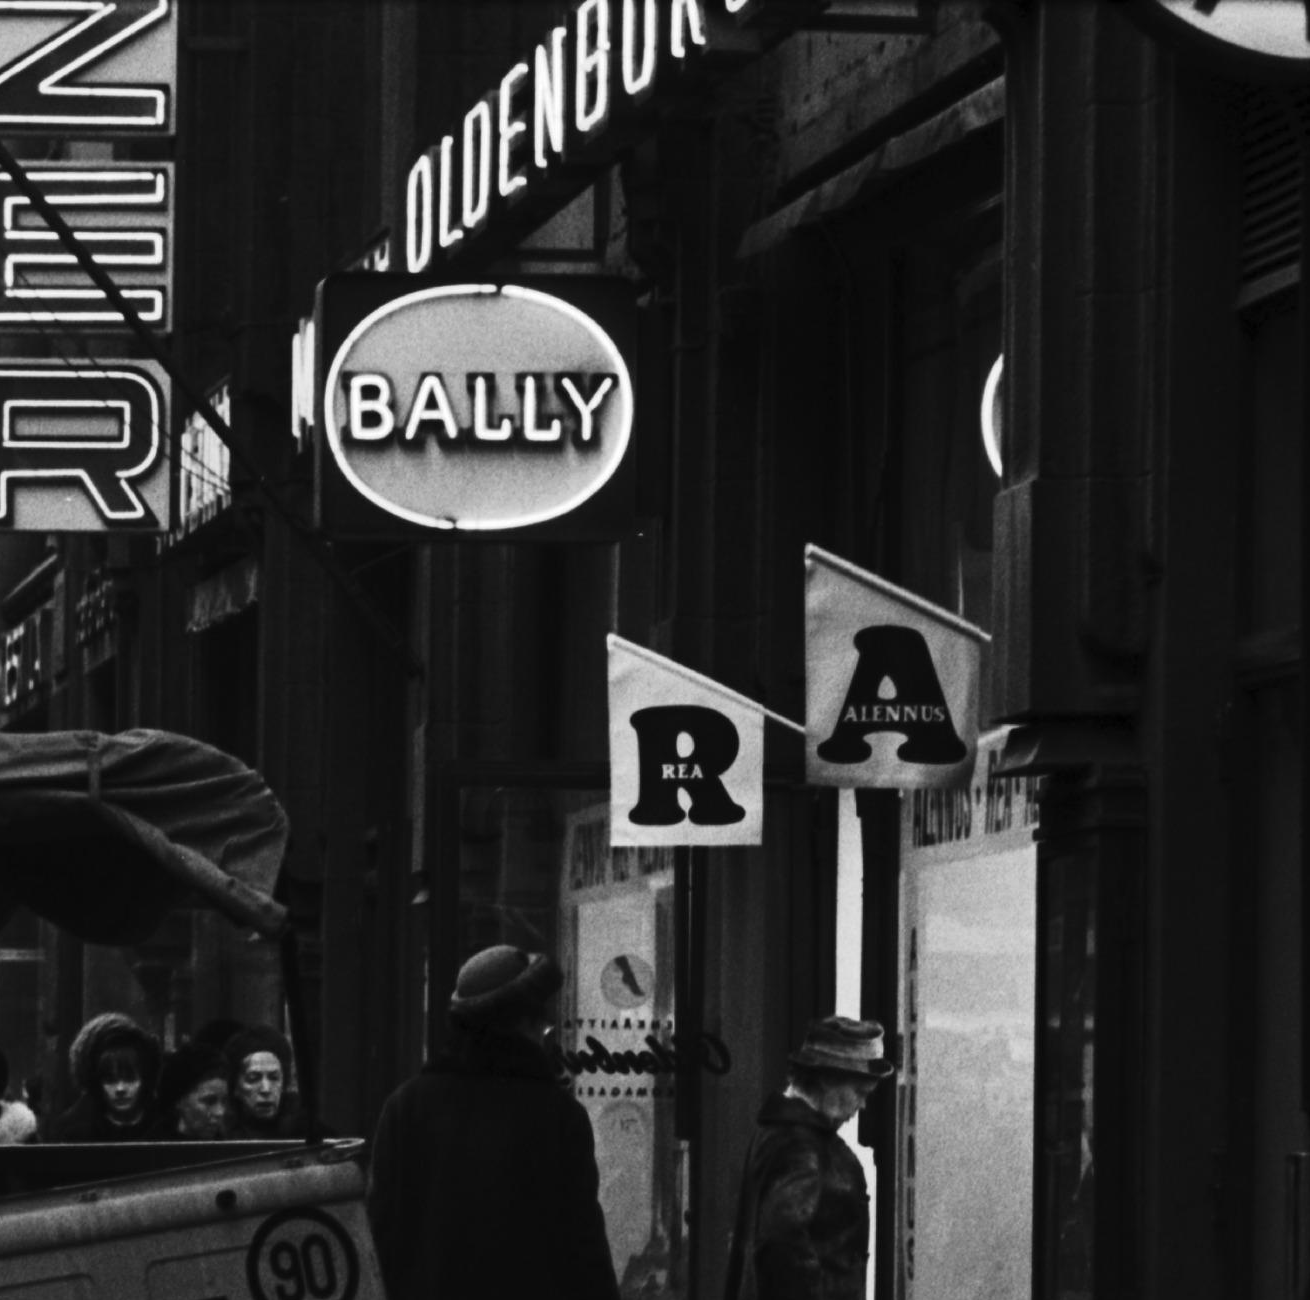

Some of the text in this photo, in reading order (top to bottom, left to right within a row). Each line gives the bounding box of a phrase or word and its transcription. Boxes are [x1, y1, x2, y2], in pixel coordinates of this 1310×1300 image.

[346, 373, 616, 443] BALLY
[817, 624, 967, 765] A
[842, 704, 946, 723] ALENNUS
[629, 705, 746, 826] R
[661, 763, 704, 781] REA
